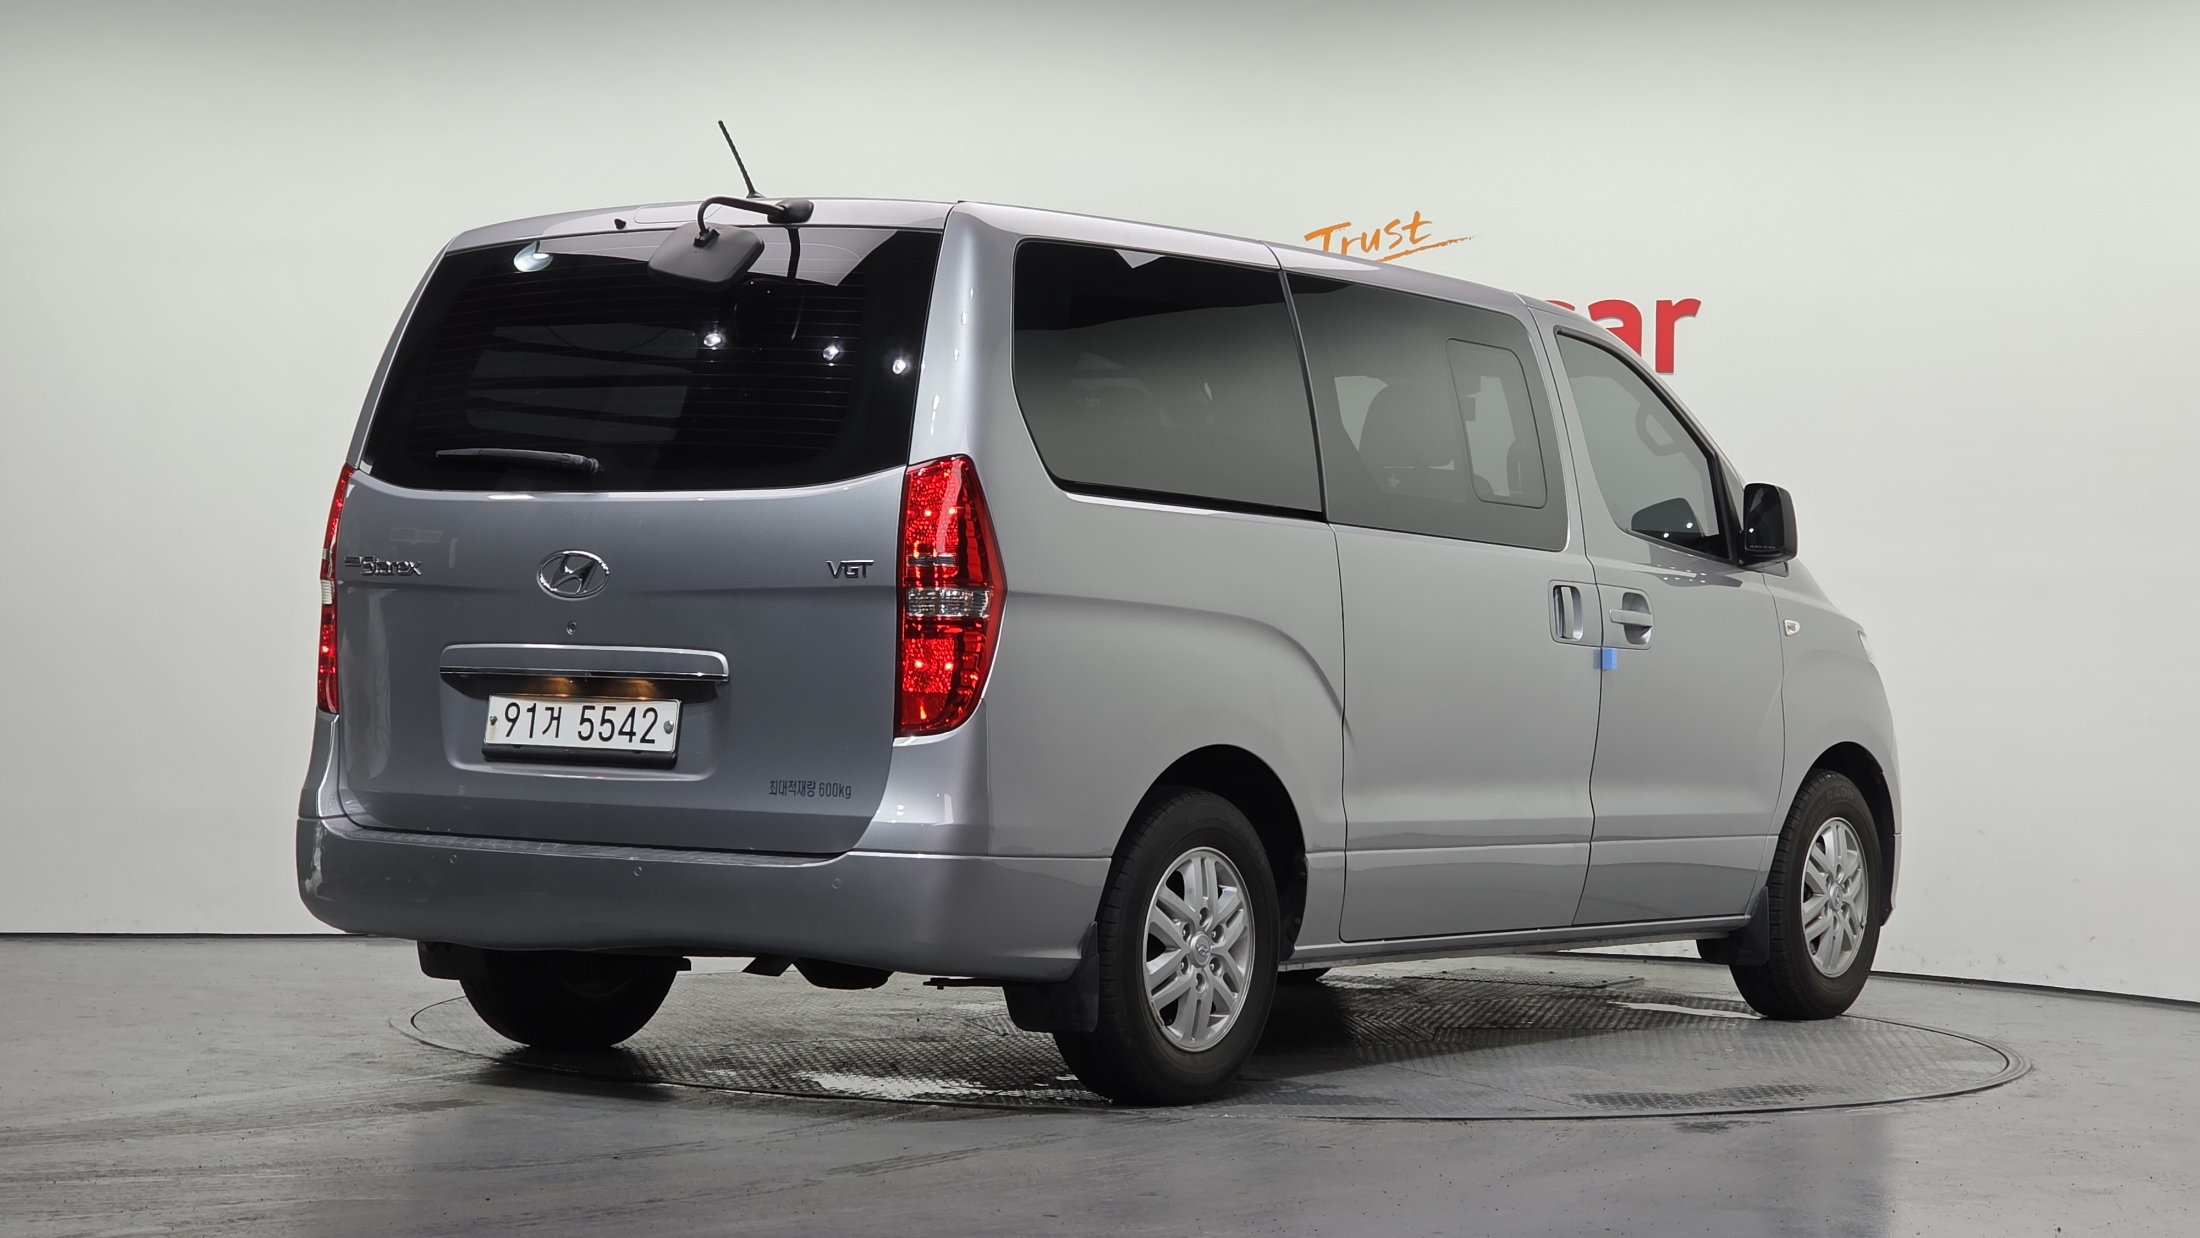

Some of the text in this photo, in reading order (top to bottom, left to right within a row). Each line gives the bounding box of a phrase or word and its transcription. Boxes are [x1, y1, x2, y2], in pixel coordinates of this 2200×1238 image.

[1304, 211, 1433, 256] Trust
[1545, 298, 1702, 374] ar
[826, 559, 875, 579] VGT
[504, 702, 659, 745] 91거 5542
[768, 779, 852, 800] 최대적재량 600kg
